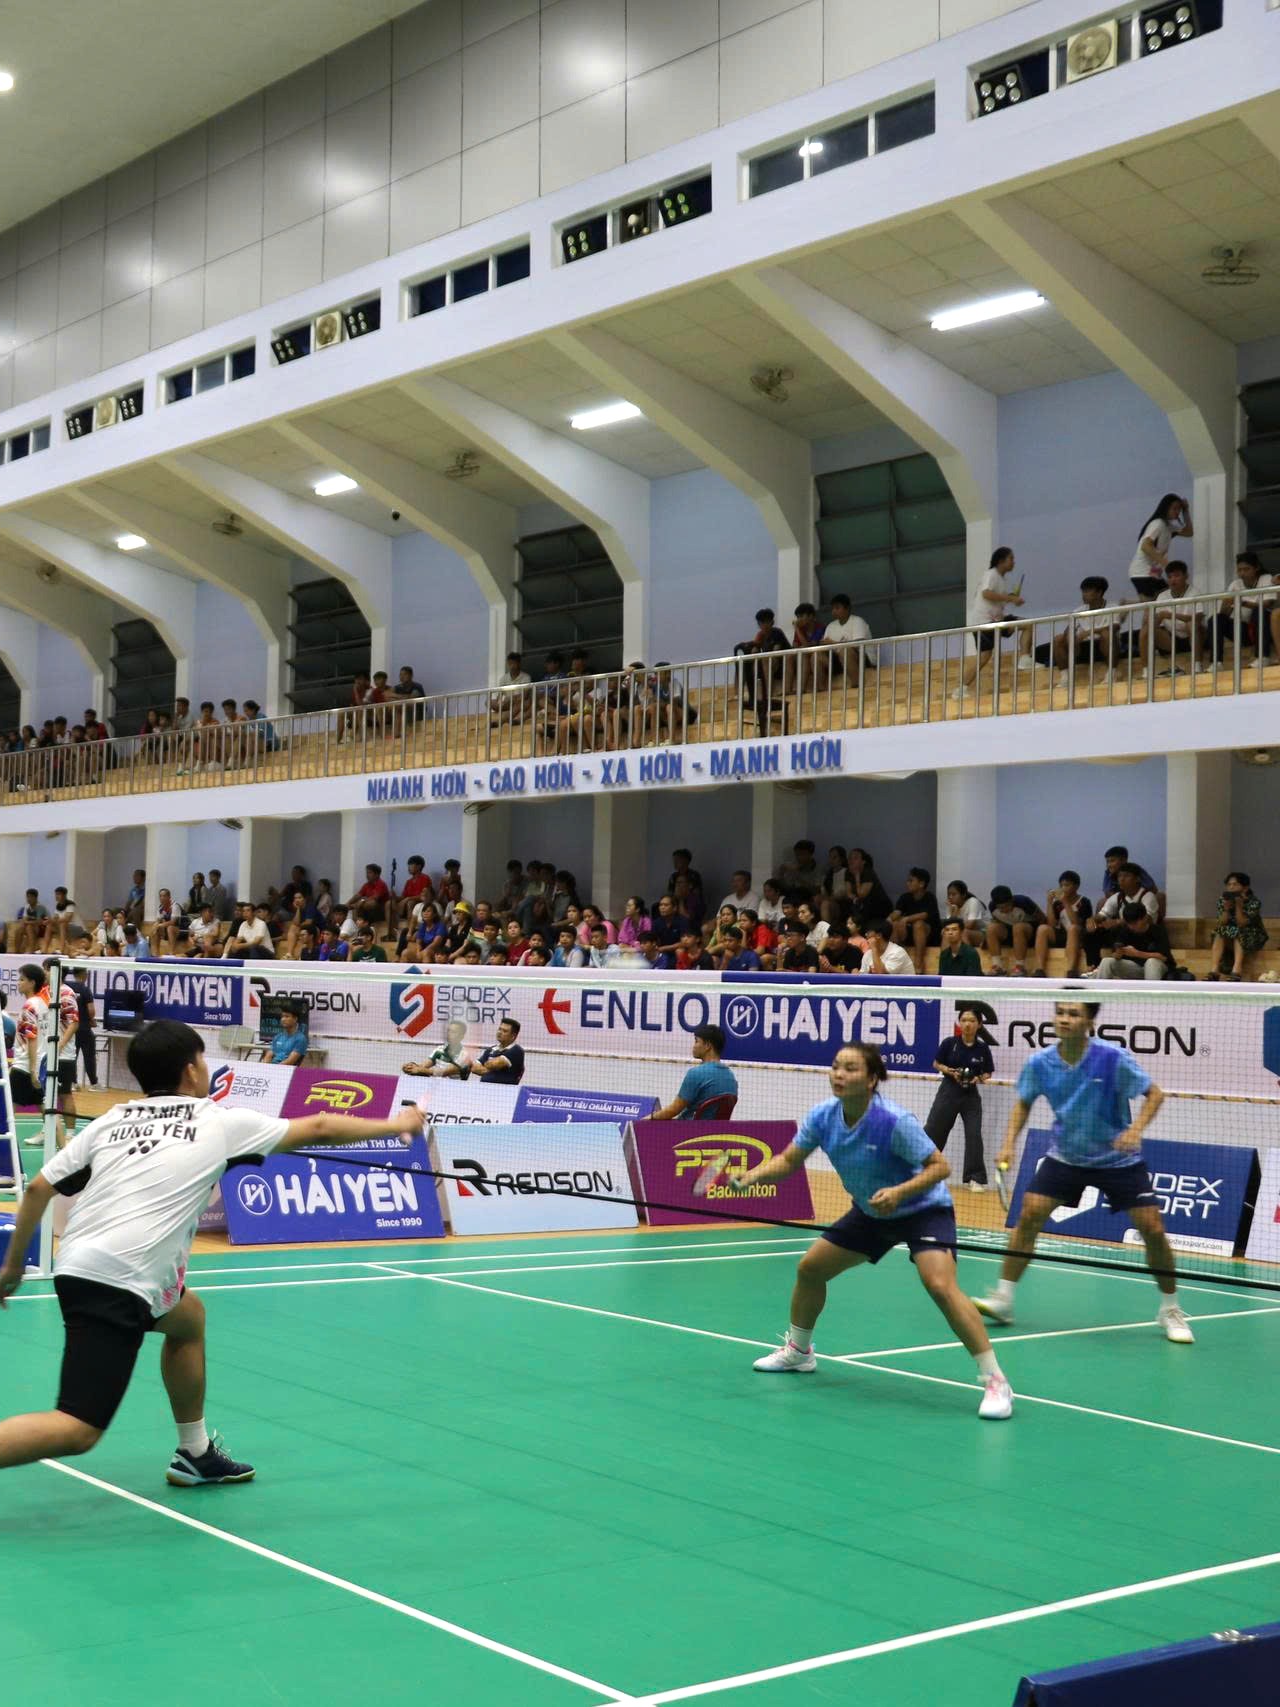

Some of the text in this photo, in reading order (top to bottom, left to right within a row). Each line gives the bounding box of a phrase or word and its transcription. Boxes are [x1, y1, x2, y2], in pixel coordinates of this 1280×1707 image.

[367, 775, 424, 801] NHANH
[432, 769, 466, 797] HƠN
[489, 766, 526, 793] CAO
[535, 759, 573, 789] HƠN
[601, 758, 628, 785] XA
[640, 750, 683, 782] HƠN
[791, 736, 842, 770] HƠN
[437, 985, 512, 1004] SODEX
[437, 1005, 511, 1024] SPORT
[580, 988, 710, 1033] ENLIO
[1008, 1020, 1196, 1056] RESON
[890, 1053, 915, 1064] 1990
[230, 1086, 268, 1098] SPORT
[234, 1075, 270, 1087] SODEX
[304, 1088, 357, 1109] PRO
[163, 1120, 197, 1143] YÊN
[369, 1139, 386, 1149] THI
[275, 1158, 346, 1214] HẢI
[496, 1170, 613, 1195] REDSON
[1149, 1172, 1224, 1198] DEX
[1154, 1194, 1220, 1219] ORT
[376, 1217, 423, 1228] Since 1990
